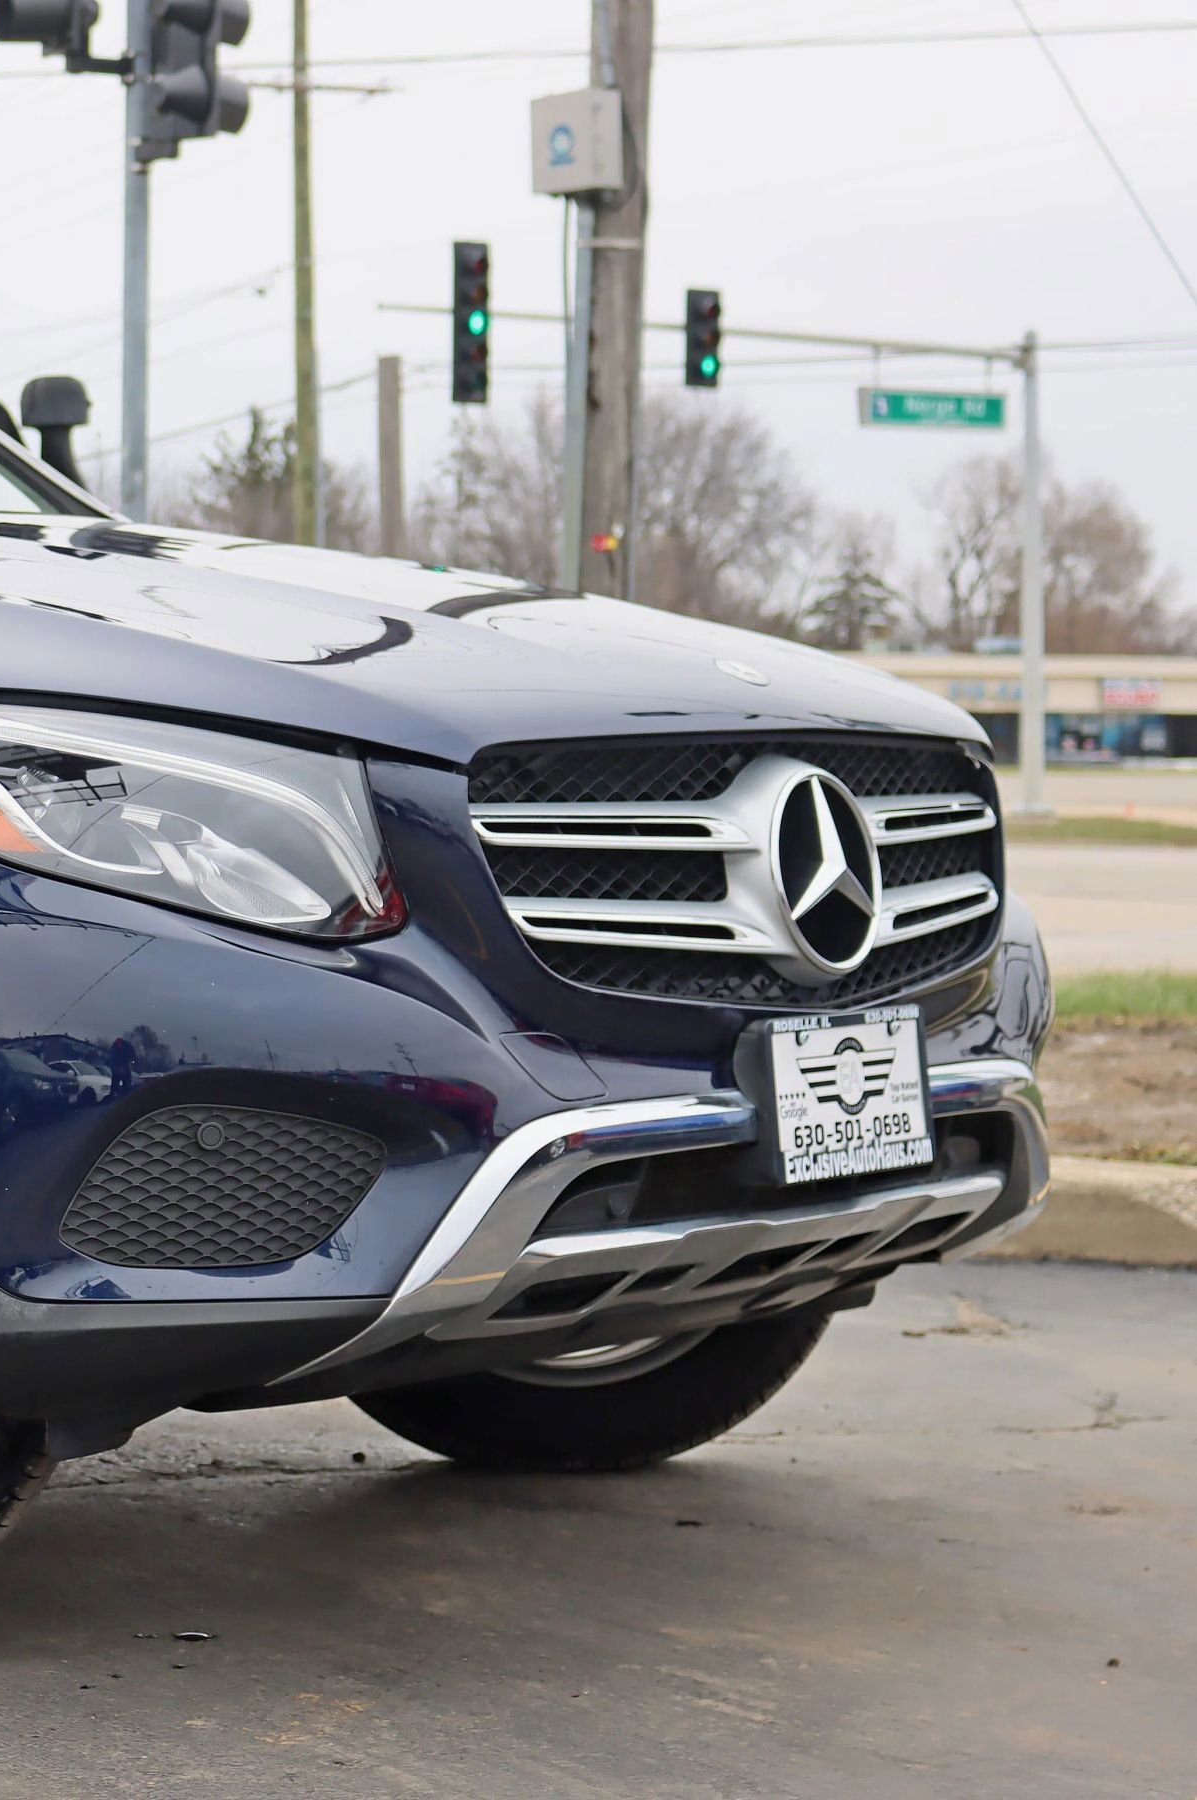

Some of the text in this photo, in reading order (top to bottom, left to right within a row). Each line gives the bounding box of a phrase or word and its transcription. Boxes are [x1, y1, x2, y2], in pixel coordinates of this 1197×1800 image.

[780, 1104, 809, 1121] Google
[794, 1113, 911, 1148] 630-501-0698
[785, 1137, 934, 1185] ExclusiveAutoHaus.com
